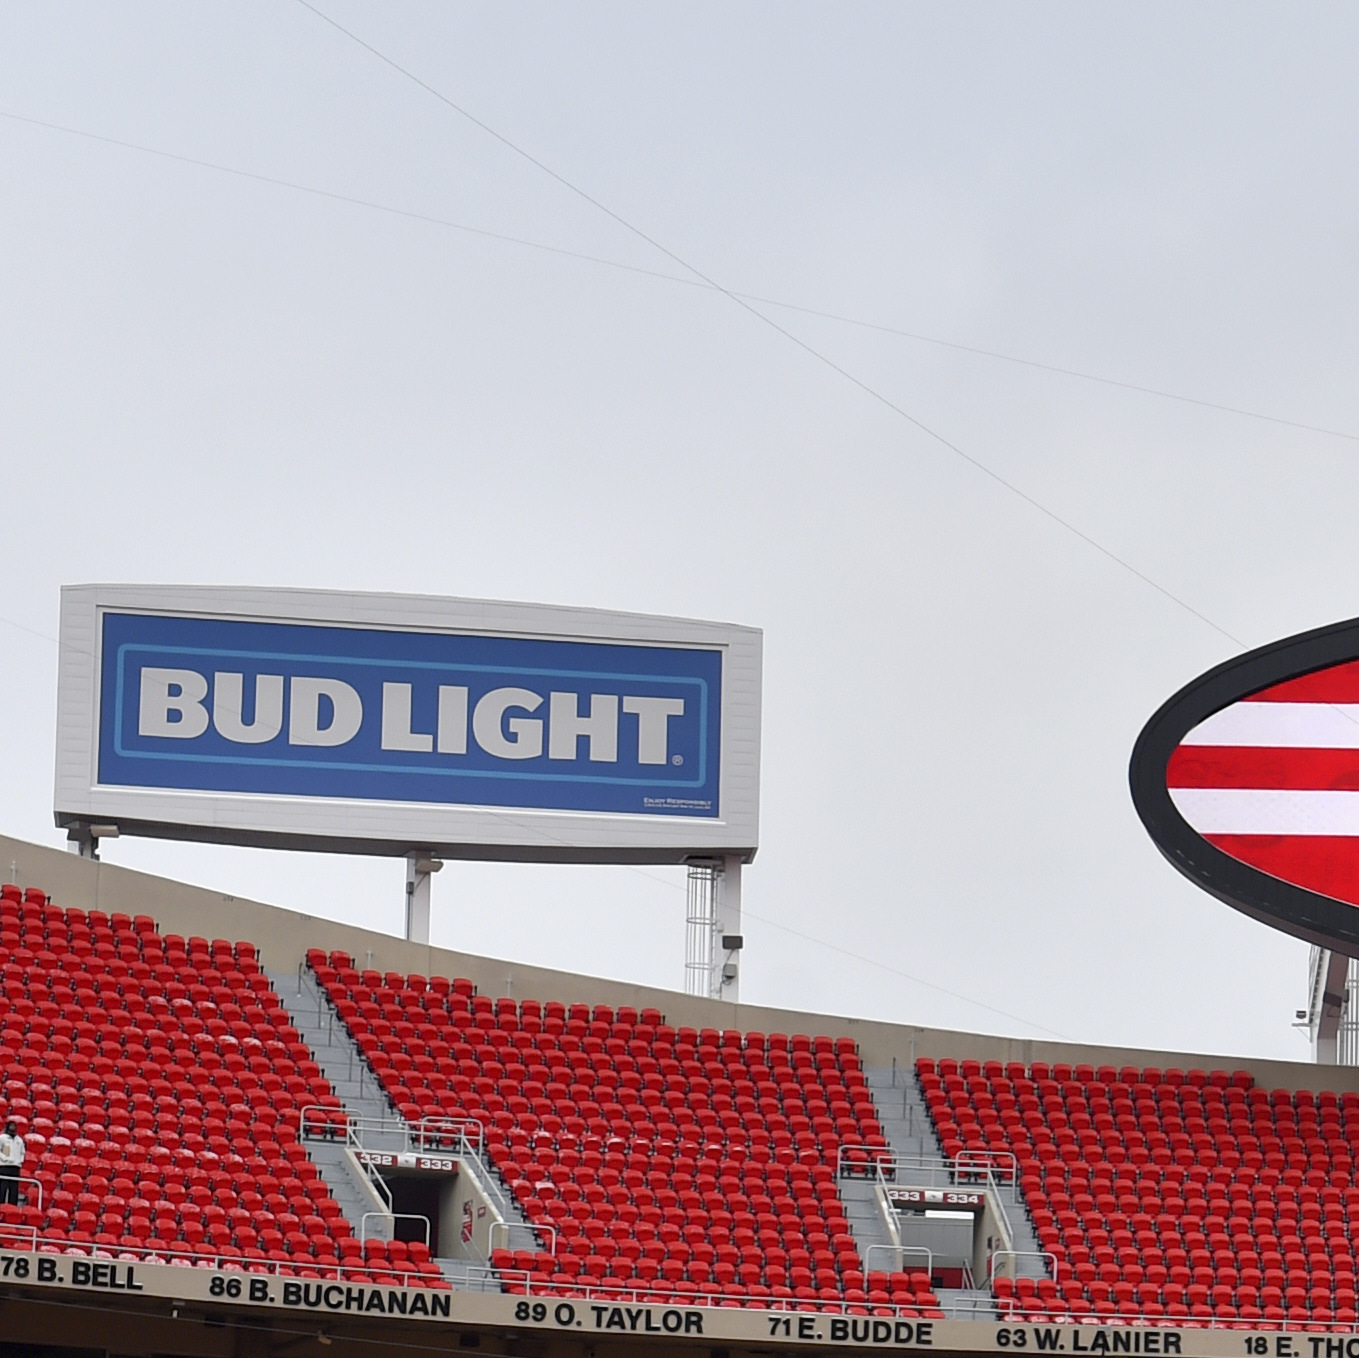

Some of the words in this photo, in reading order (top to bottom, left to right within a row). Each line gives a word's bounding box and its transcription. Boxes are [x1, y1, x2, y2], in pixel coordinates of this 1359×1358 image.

[139, 667, 362, 747] BUD
[381, 681, 685, 765] LIGHT
[360, 1153, 393, 1166] 332
[420, 1159, 453, 1171] 333
[887, 1189, 920, 1201] 333
[946, 1192, 979, 1205] 334
[39, 1257, 65, 1284] B.
[71, 1261, 143, 1292] BELL
[209, 1274, 242, 1299] 86
[248, 1277, 276, 1304] B.
[283, 1282, 451, 1319] BUCHANAN
[515, 1301, 547, 1324] 89
[554, 1303, 584, 1329] O.
[590, 1305, 704, 1336] TAYLOR
[769, 1316, 791, 1337] 71
[800, 1316, 823, 1341] E.
[831, 1319, 933, 1346] BUDDE
[996, 1328, 1027, 1348] 63
[1033, 1328, 1066, 1353] W.
[1072, 1329, 1183, 1355] LANIER
[1244, 1337, 1269, 1356] 18
[1277, 1336, 1301, 1358] E.
